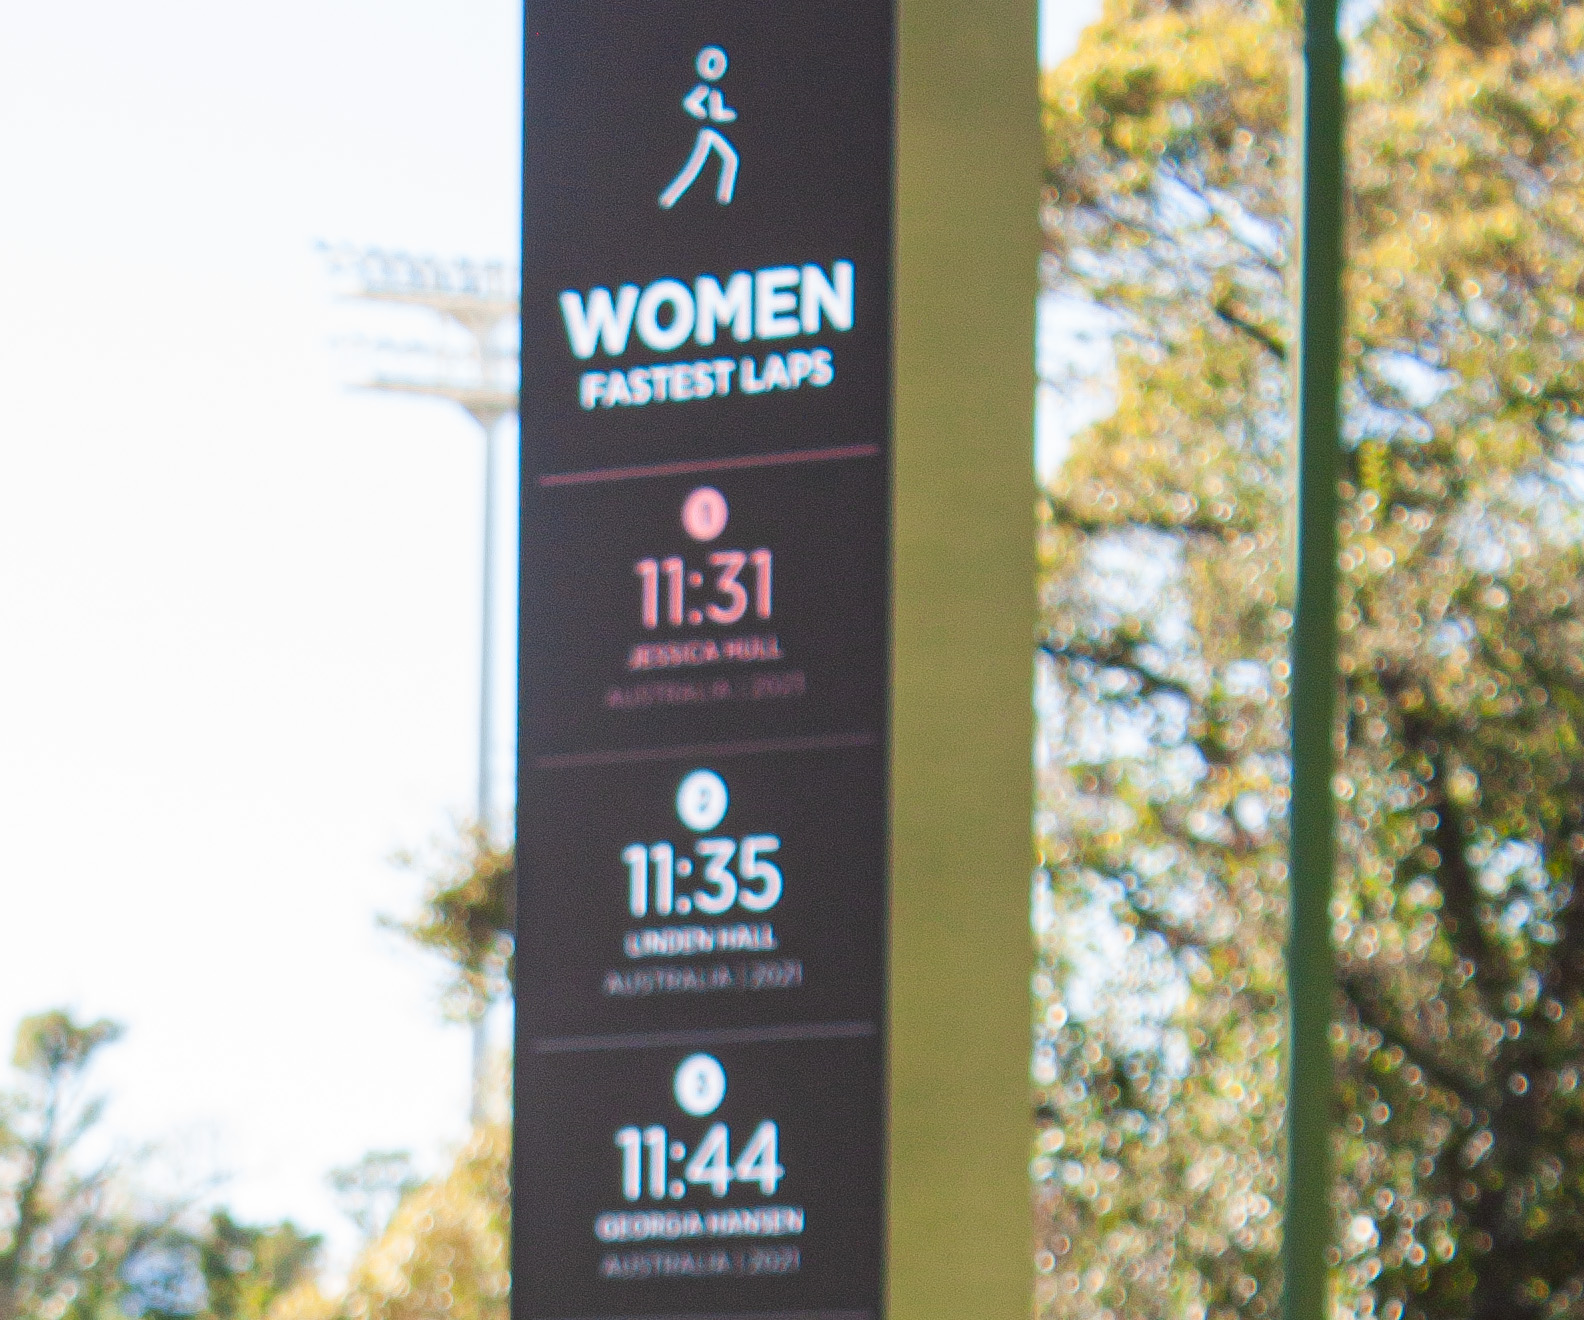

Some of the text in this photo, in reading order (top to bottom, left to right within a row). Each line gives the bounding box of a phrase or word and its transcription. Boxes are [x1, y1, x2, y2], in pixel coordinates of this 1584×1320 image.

[560, 259, 855, 360] WOMEN
[580, 347, 834, 410] FASTEST LAPS
[636, 548, 774, 629] 11:31
[622, 833, 783, 917] 11:35
[614, 1117, 786, 1202] 11:44
